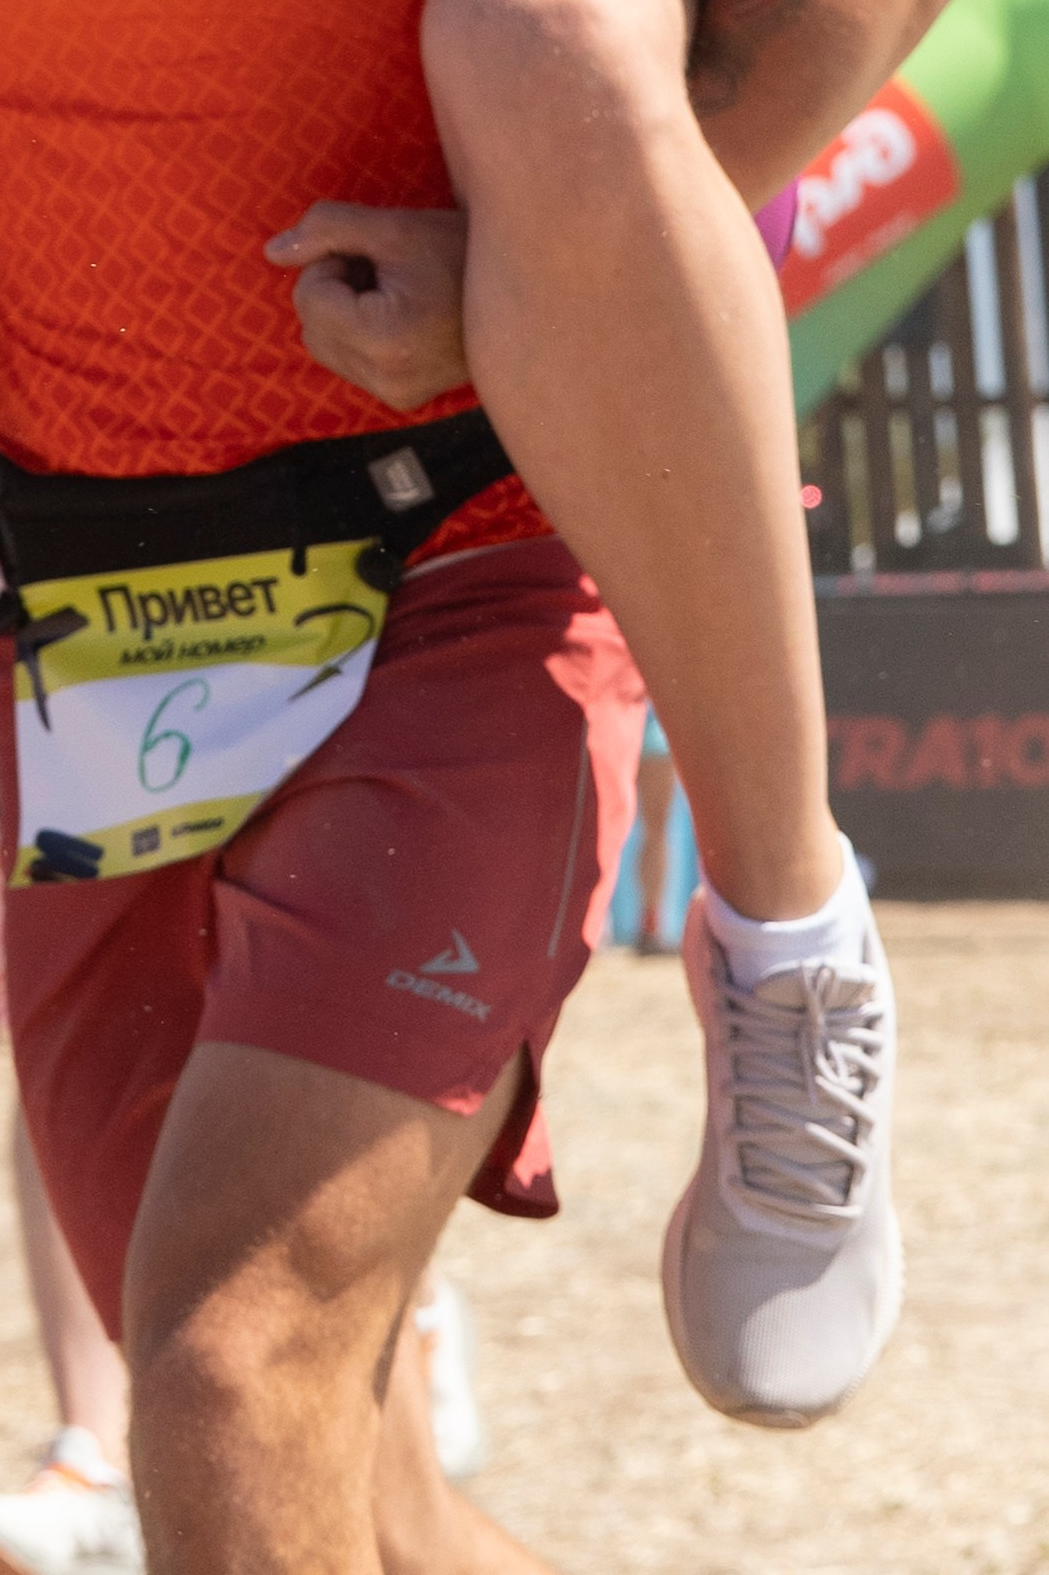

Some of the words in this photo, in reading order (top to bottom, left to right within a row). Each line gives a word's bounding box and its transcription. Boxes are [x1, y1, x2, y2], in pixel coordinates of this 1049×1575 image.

[99, 576, 279, 642] Привет
[138, 678, 210, 794] 6
[386, 969, 492, 1022] DEMIX
